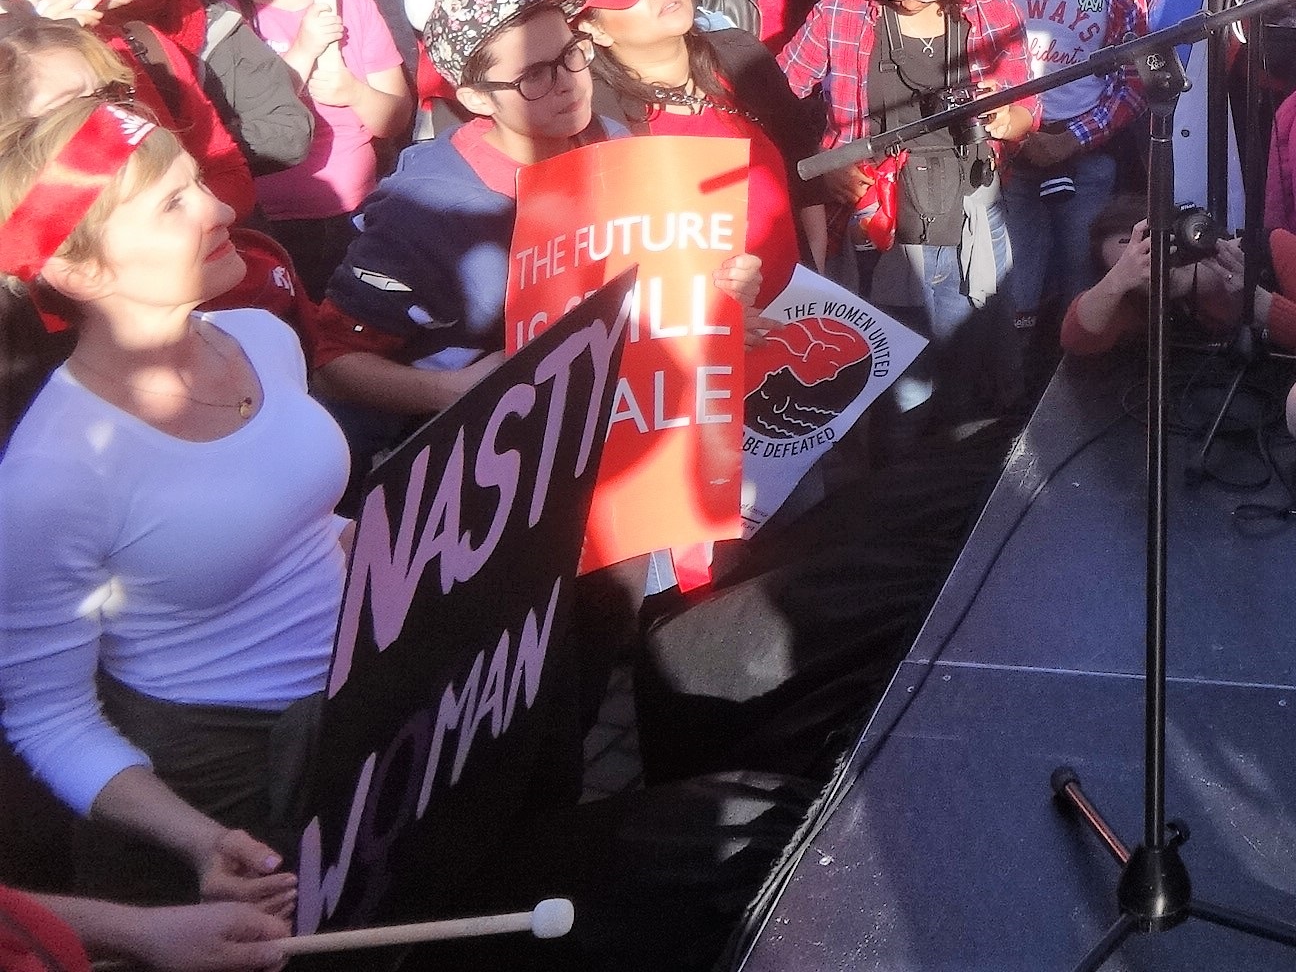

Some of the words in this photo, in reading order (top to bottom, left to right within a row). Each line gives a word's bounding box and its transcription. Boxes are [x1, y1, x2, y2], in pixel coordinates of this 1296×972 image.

[515, 239, 565, 291] THE
[573, 212, 734, 272] FUTURE
[783, 302, 818, 321] THE
[823, 301, 877, 333] WOMEN
[868, 329, 890, 379] UNITED
[605, 366, 733, 444] ALE
[763, 427, 836, 458] DEFEATED
[328, 293, 634, 701] NASTY
[295, 575, 562, 937] WOMAN
